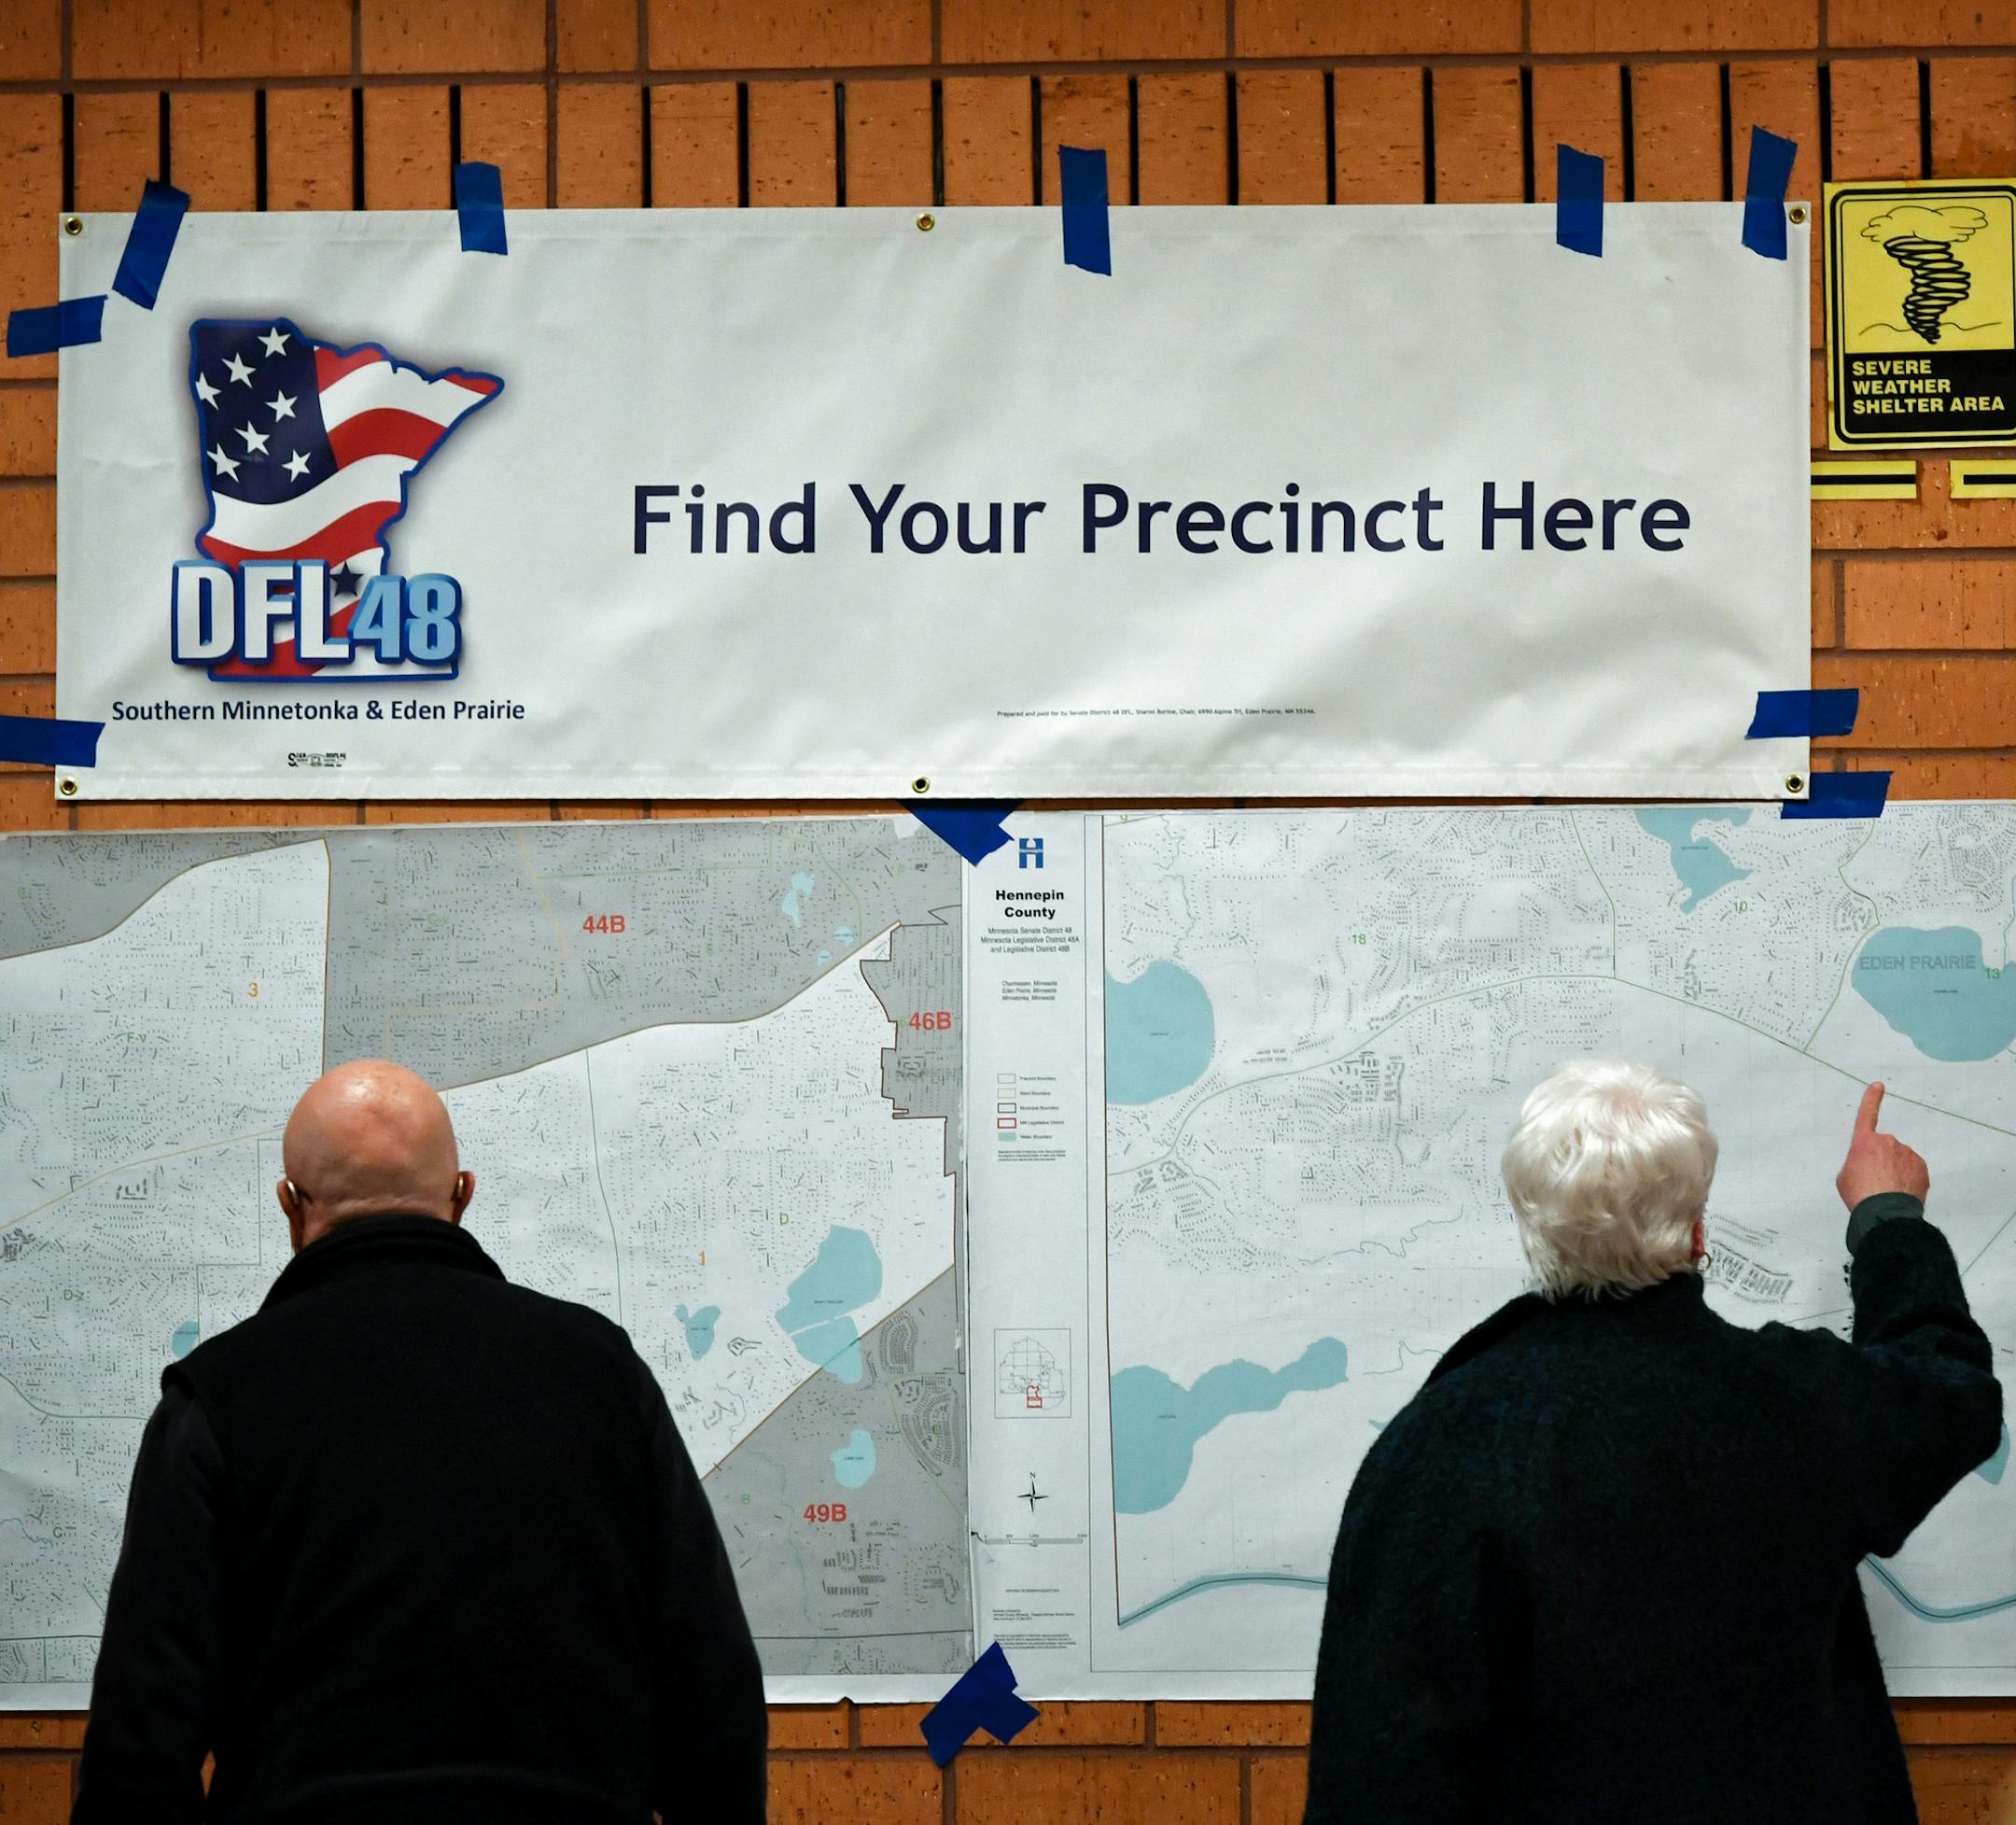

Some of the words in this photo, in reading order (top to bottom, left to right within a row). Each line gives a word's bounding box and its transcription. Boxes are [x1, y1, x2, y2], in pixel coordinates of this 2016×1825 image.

[1852, 359, 1932, 376] SEVERE
[1853, 378, 1952, 396] WEATHER
[1853, 398, 1944, 414] SHELTER
[1950, 396, 2005, 412] AREA
[634, 481, 816, 555] Find
[848, 483, 1047, 555] Your
[1082, 482, 1445, 555] Precinct
[1481, 480, 1691, 552] Here
[111, 699, 216, 721] Southern
[221, 699, 359, 721] Minnetonka
[365, 699, 385, 721] &
[390, 699, 446, 721] Eden
[452, 698, 525, 721] Prairie
[995, 889, 1064, 903] Hennepin
[1004, 906, 1056, 920] County
[582, 913, 625, 934] 44B
[1012, 935, 1044, 946] Legislative
[1351, 934, 1367, 946] 18
[1003, 945, 1035, 954] Legislative
[1036, 944, 1057, 953] District
[1859, 956, 1905, 970] EDEN
[1910, 954, 1976, 969] PRAIRIE
[248, 982, 259, 998] 3
[909, 1011, 951, 1031] 46B
[779, 1212, 789, 1225] D
[1029, 1471, 1036, 1479] N
[803, 1503, 847, 1523] 49B
[53, 1526, 63, 1539] G
